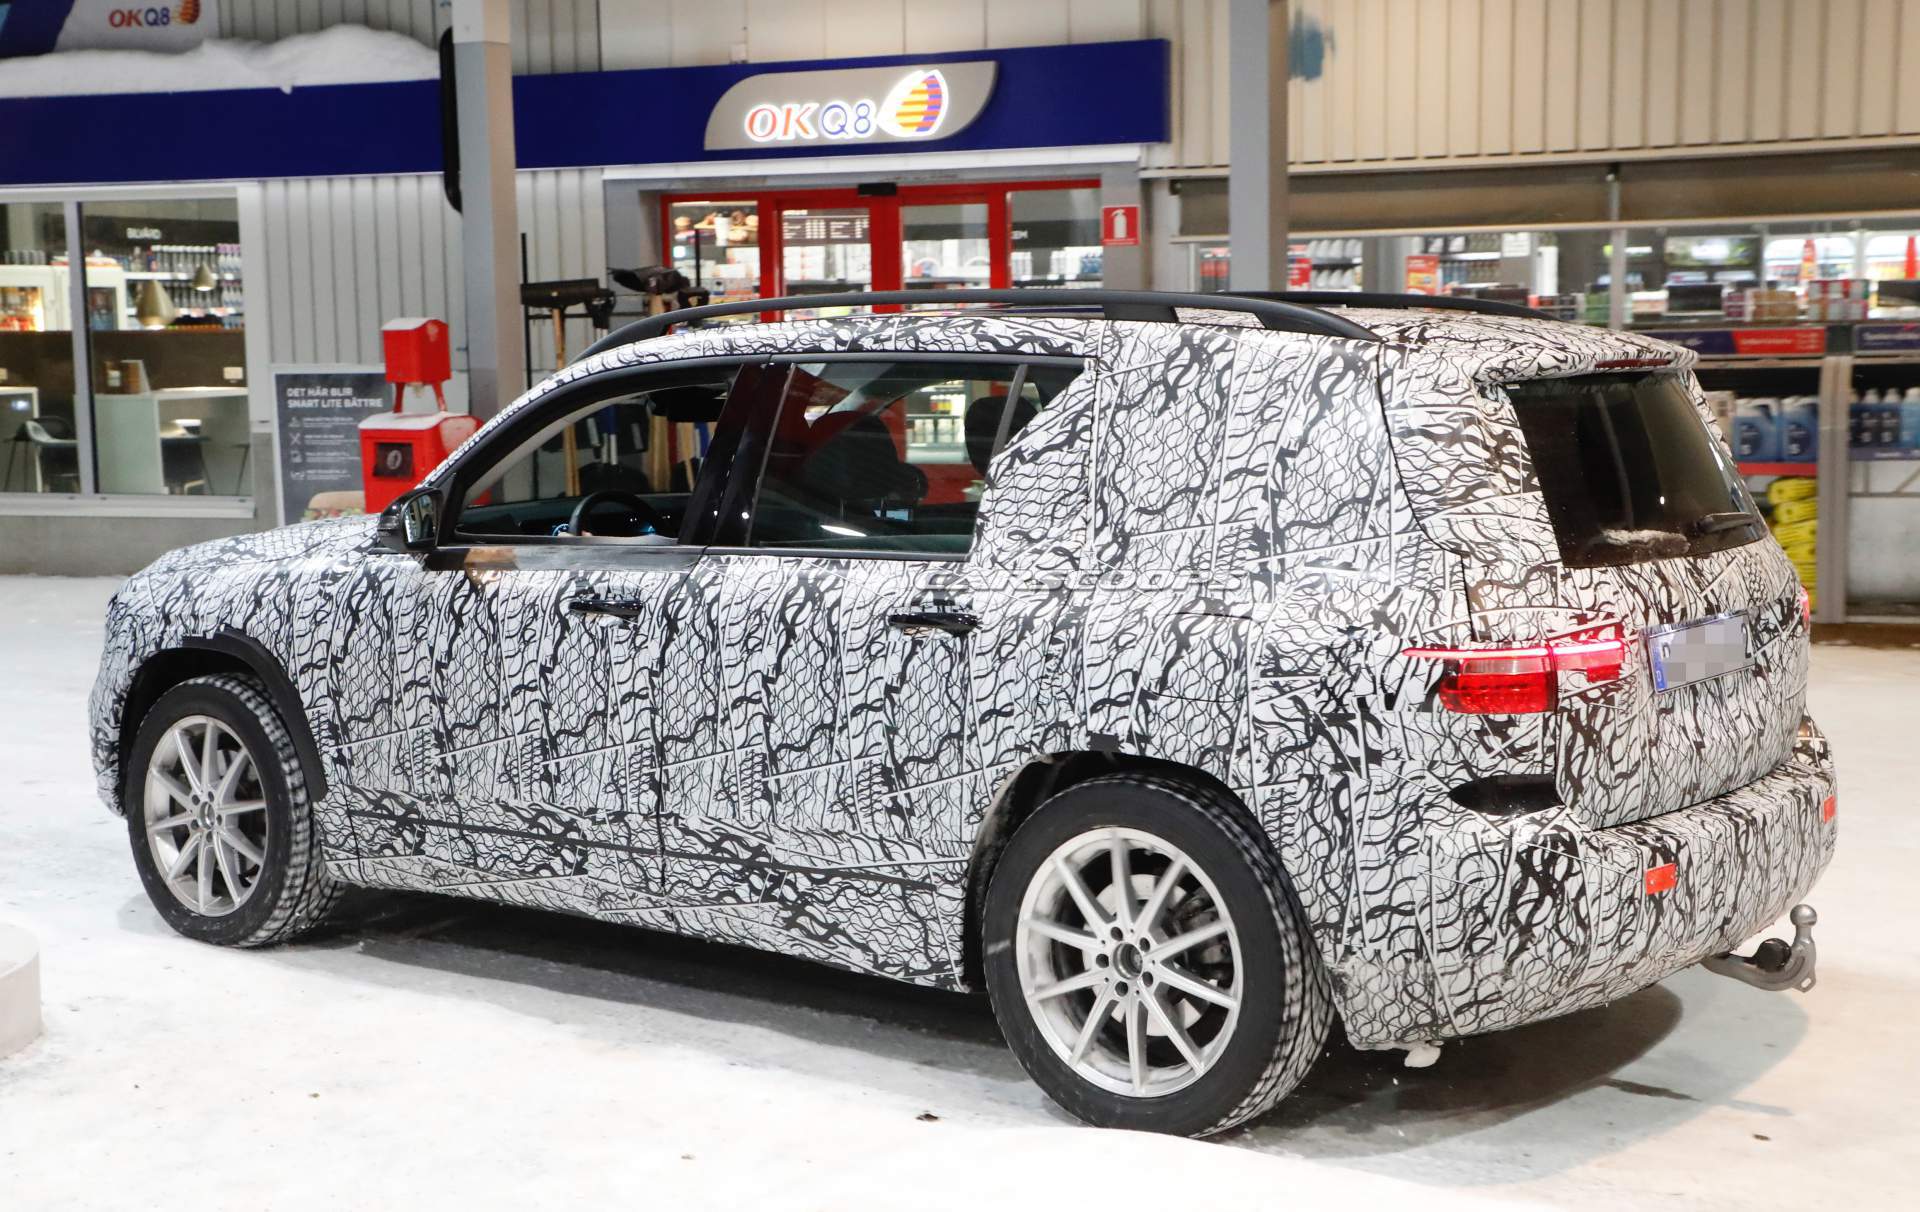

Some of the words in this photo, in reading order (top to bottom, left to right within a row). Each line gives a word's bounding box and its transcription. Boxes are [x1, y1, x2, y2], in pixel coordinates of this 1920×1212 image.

[108, 7, 171, 28] OKQ8
[747, 101, 873, 139] OKQ8
[287, 387, 306, 396] DET
[308, 386, 328, 396] HÄR
[321, 398, 342, 408] LITE
[344, 397, 383, 408] BÄTTRE
